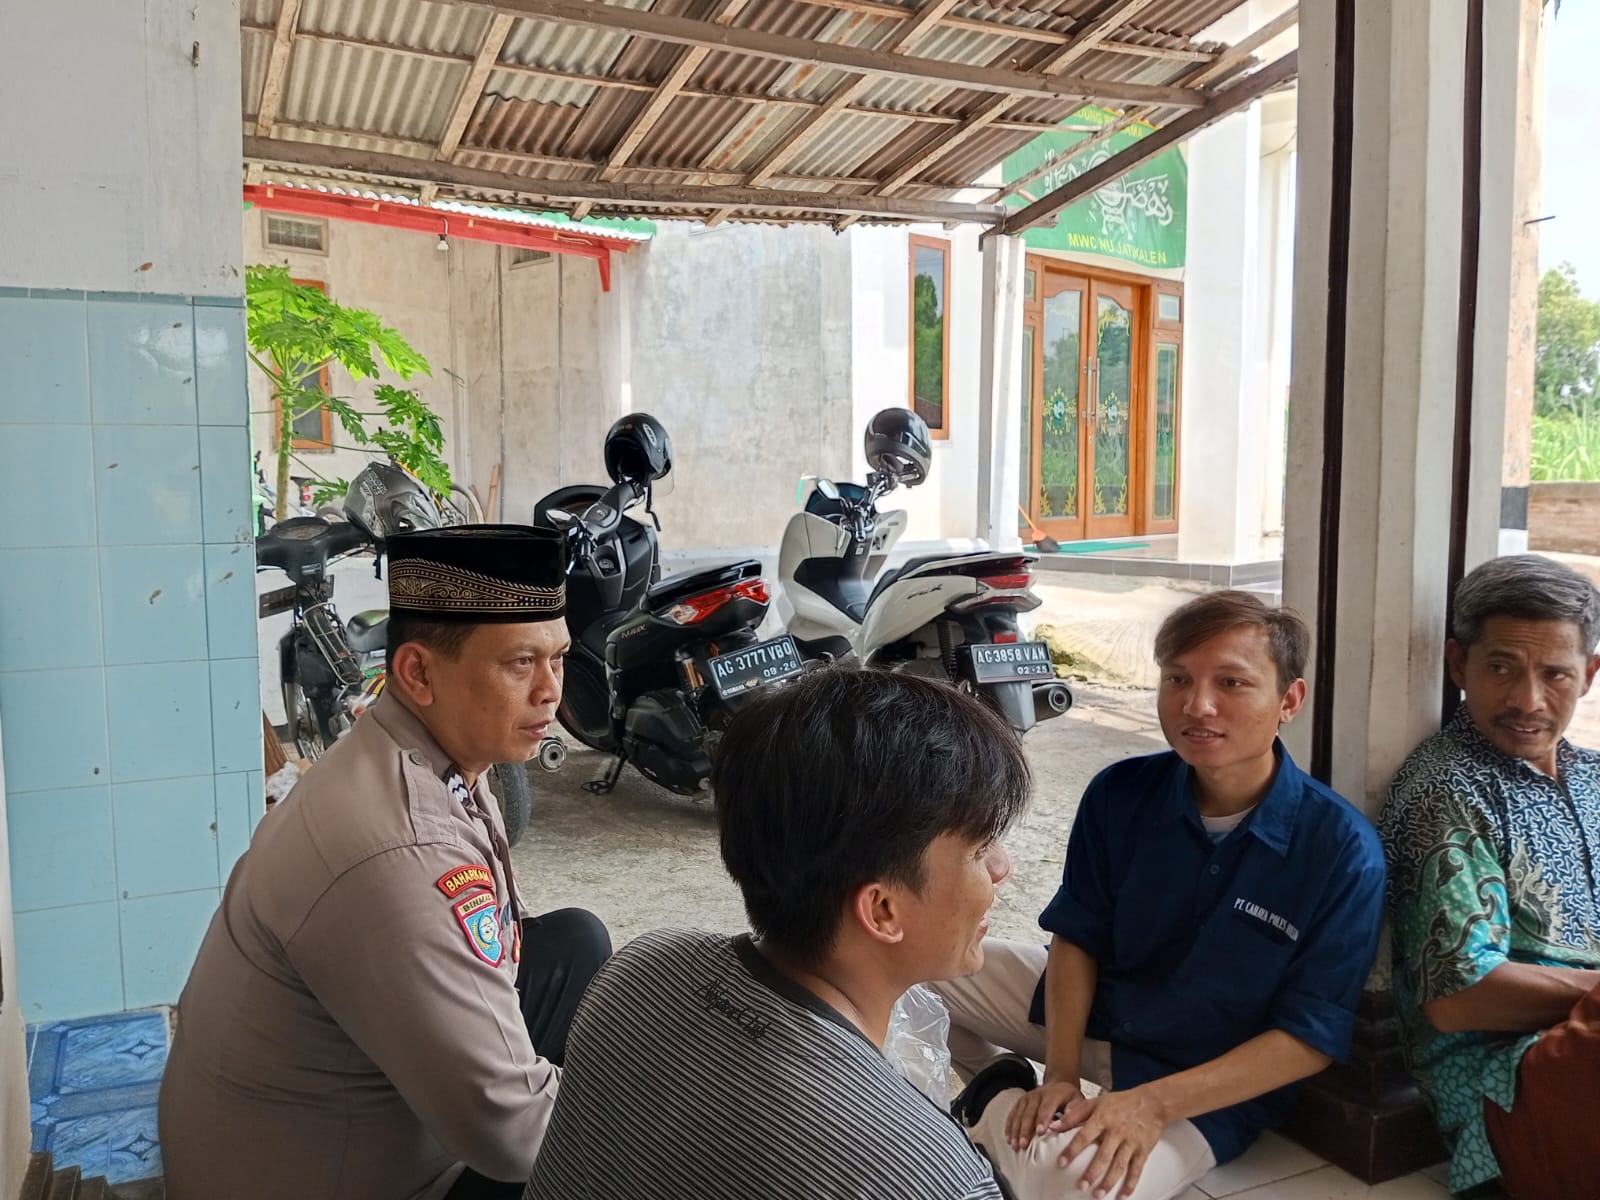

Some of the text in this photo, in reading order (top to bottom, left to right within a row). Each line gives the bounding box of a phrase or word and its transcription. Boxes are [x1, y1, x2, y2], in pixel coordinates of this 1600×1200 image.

[1068, 231, 1097, 250] MWC
[1099, 238, 1114, 253] NU
[717, 660, 734, 678] AG
[735, 648, 768, 670] 3777
[977, 649, 993, 663] AG
[993, 648, 1022, 663] 3858
[445, 868, 490, 892] BAHARKAM
[1233, 897, 1246, 911] PT.
